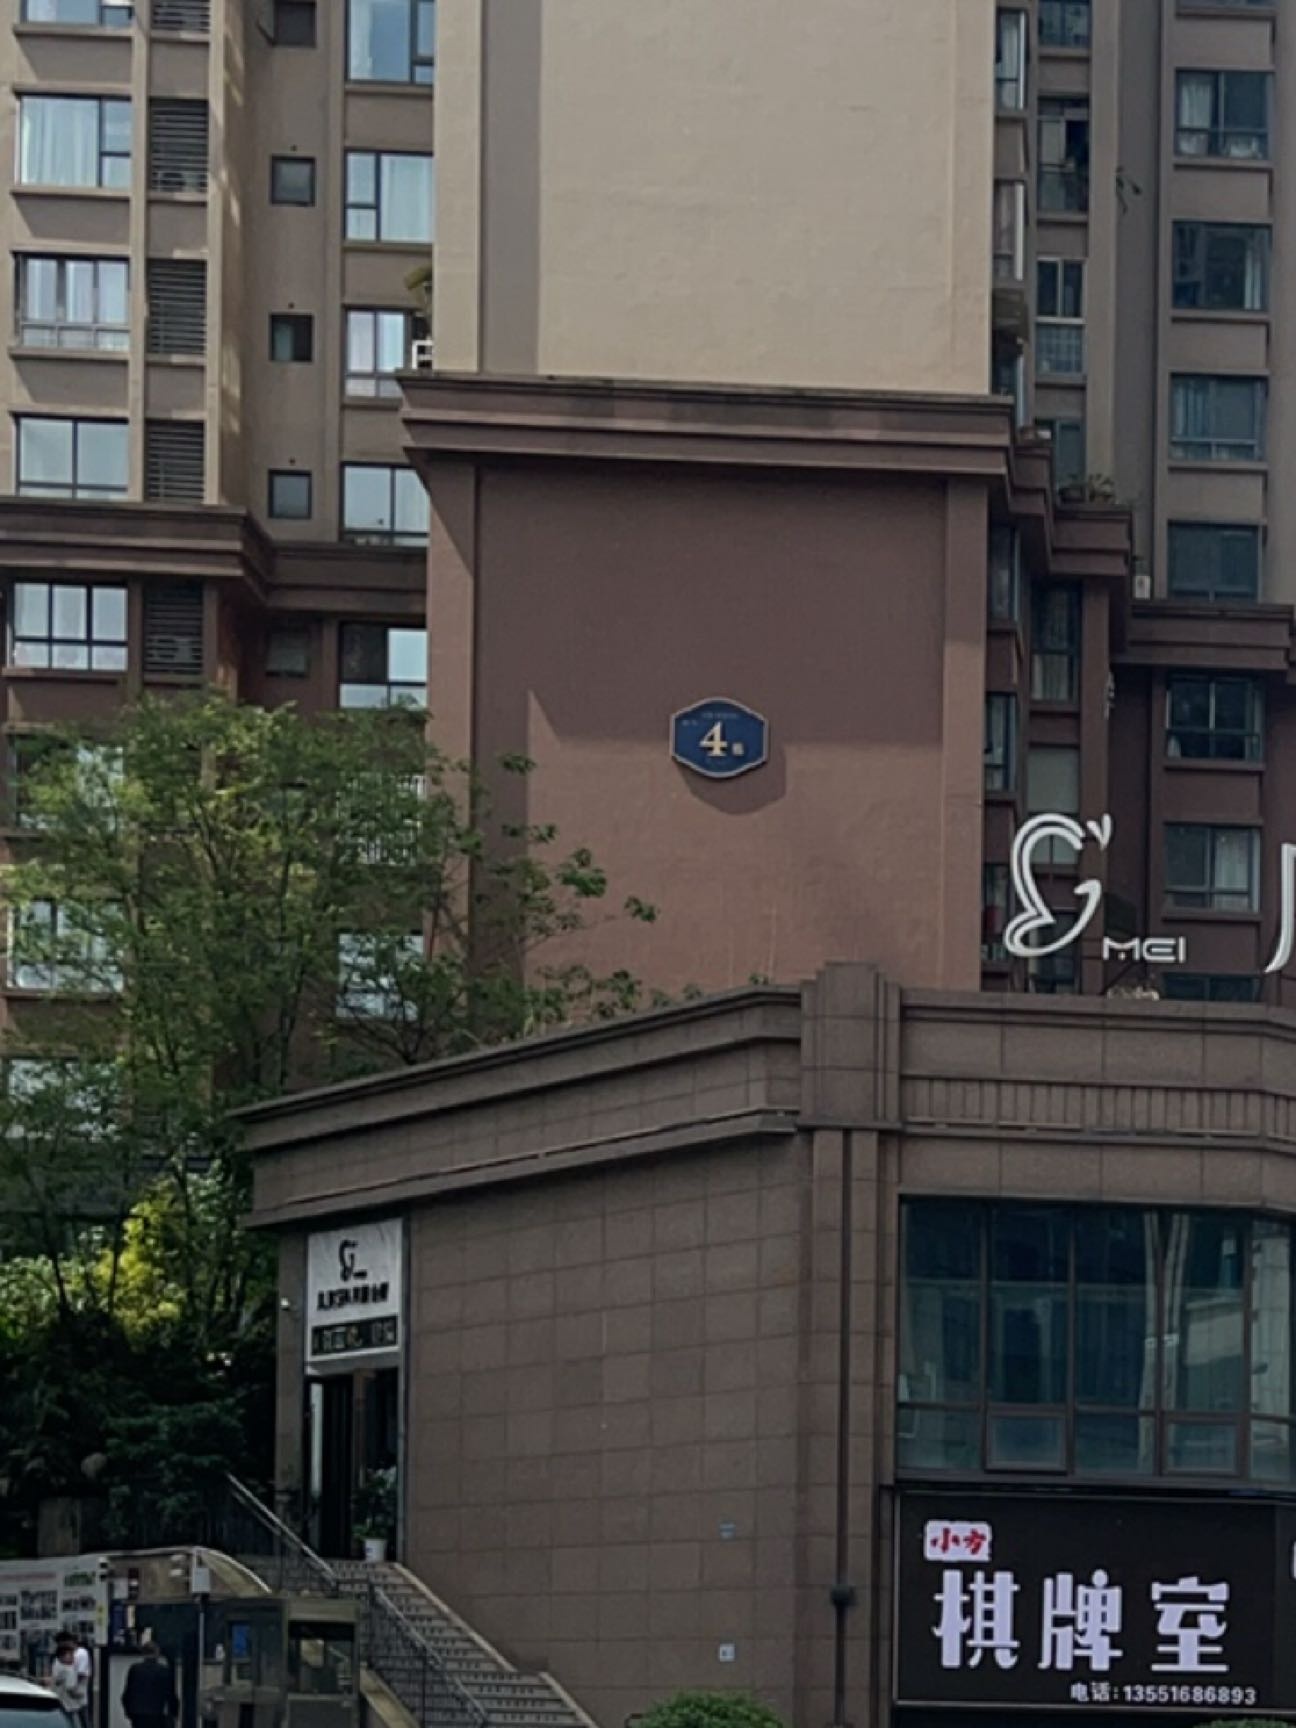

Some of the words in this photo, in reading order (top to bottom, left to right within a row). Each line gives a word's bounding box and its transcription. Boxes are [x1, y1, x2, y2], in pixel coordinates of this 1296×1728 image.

[1103, 937, 1187, 963] MEI
[930, 1527, 987, 1556] 小方
[933, 1569, 1229, 1672] 棋牌室
